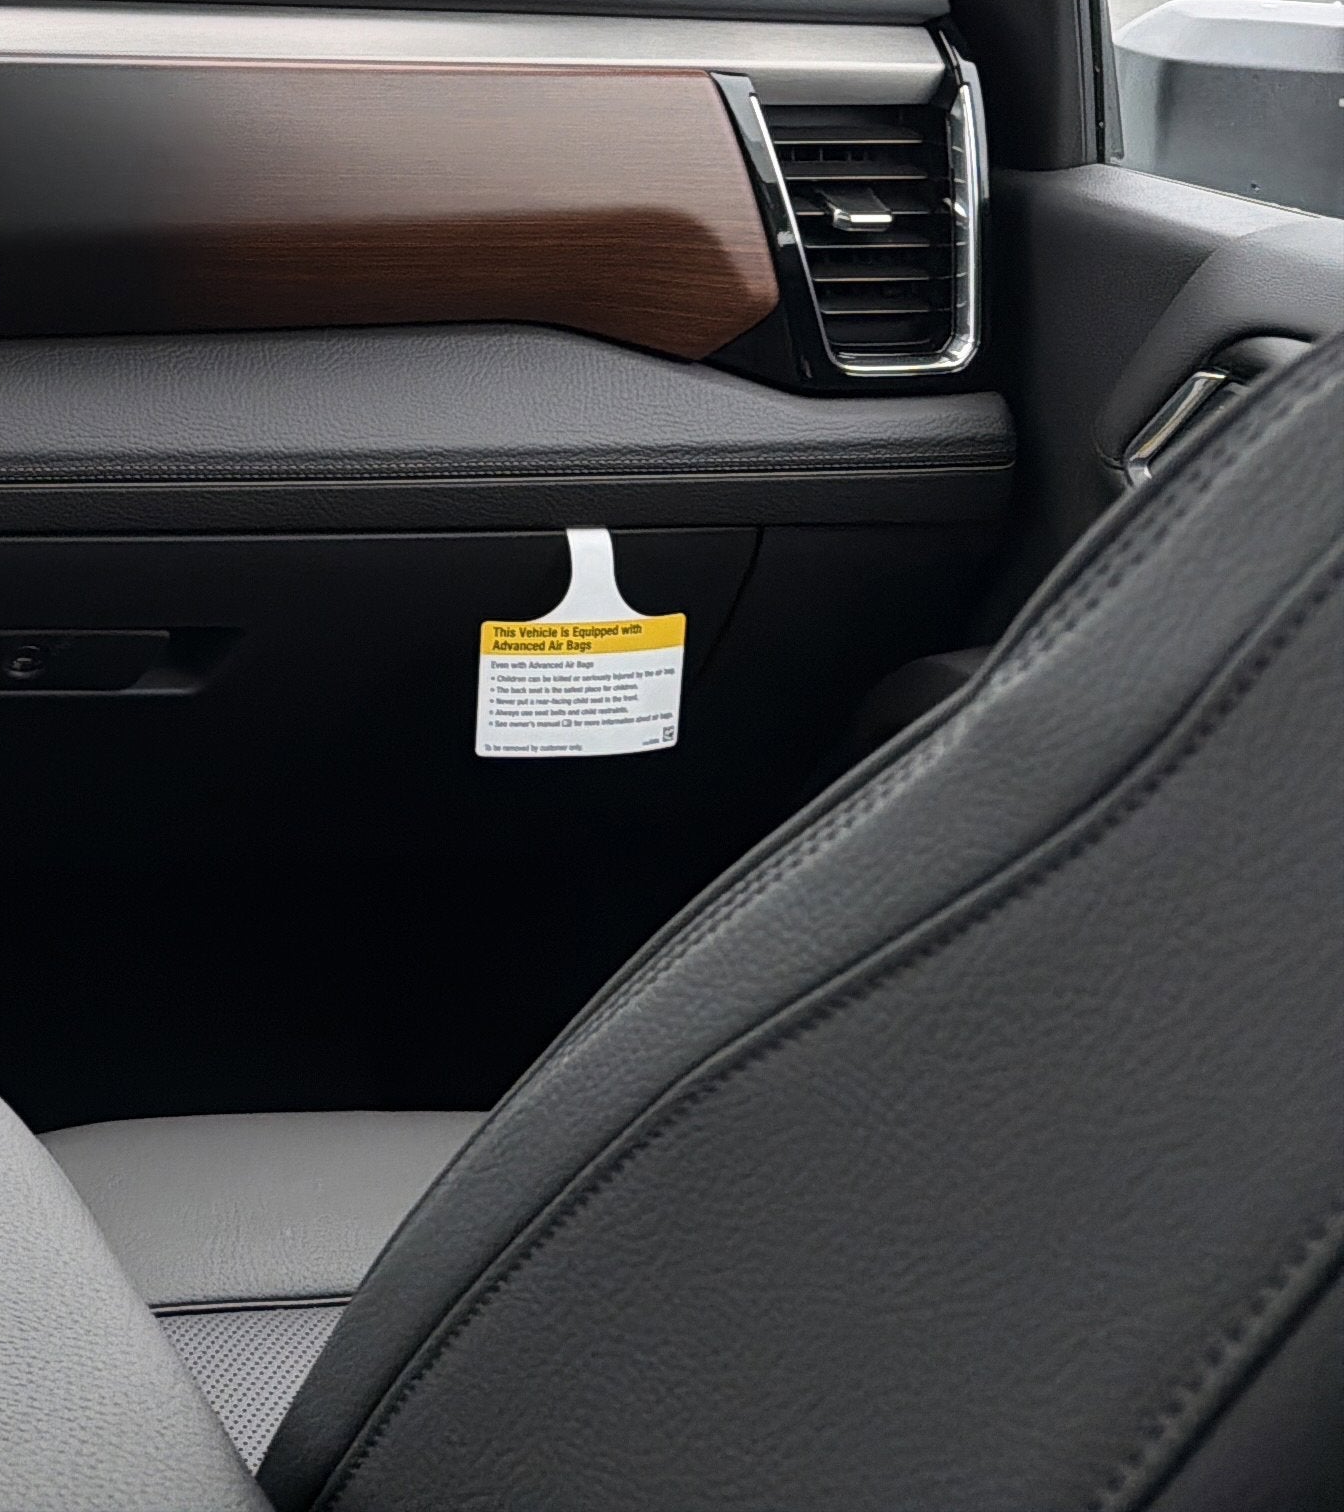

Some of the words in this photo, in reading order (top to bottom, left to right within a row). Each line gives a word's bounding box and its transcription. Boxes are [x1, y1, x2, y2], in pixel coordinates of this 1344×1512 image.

[493, 626, 517, 638] This
[518, 626, 558, 638] Vehicle
[572, 625, 619, 639] Equipped
[621, 623, 643, 635] with
[492, 639, 546, 651] Advanced
[548, 639, 564, 651] Air
[566, 639, 593, 653] Bags
[491, 661, 510, 669] Even
[510, 661, 527, 669] with
[528, 661, 564, 669] Advanced
[565, 661, 575, 669] Air
[576, 661, 594, 670] Bags
